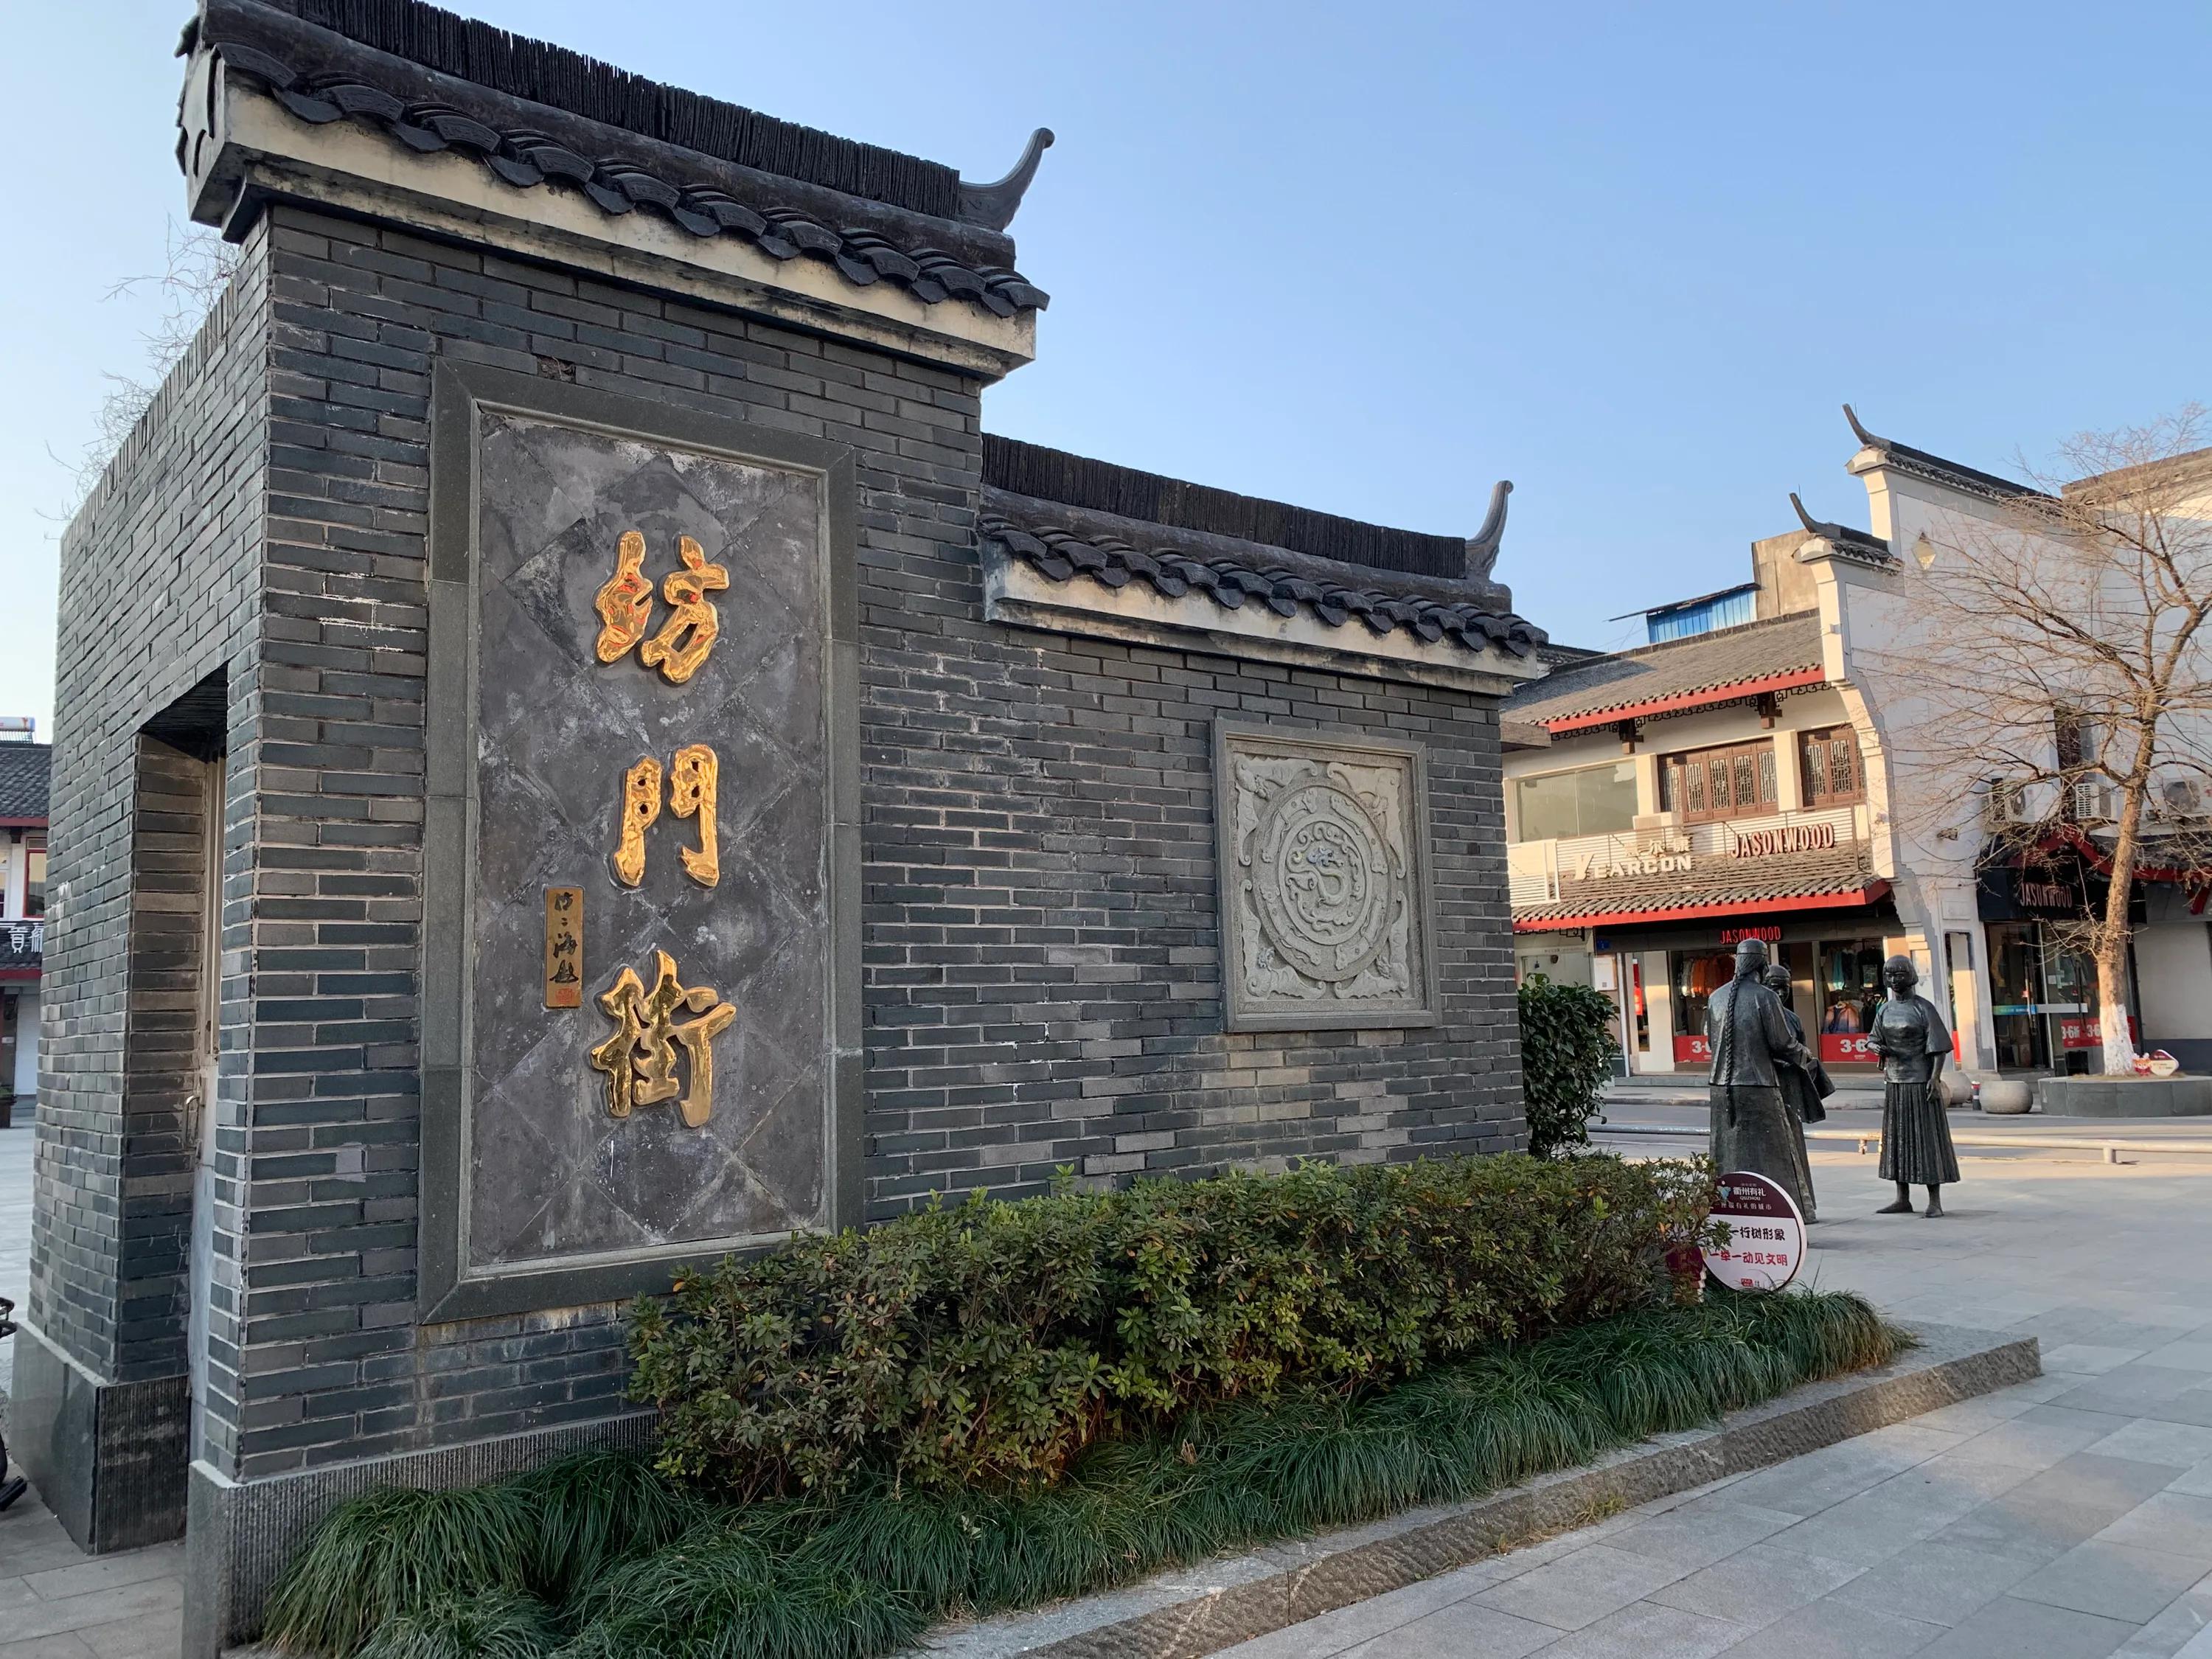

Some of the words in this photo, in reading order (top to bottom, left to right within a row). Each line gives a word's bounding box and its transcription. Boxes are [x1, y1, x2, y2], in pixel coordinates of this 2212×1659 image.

[1731, 822, 1834, 858] JASONWOOD
[1574, 854, 1692, 880] YEARCON
[1719, 926, 1781, 945] JASONWOOD
[1840, 1039, 1868, 1053] 3-6
[1733, 1186, 1767, 1197] 衢州有礼
[1710, 1250, 1788, 1266] 一举一动见文明
